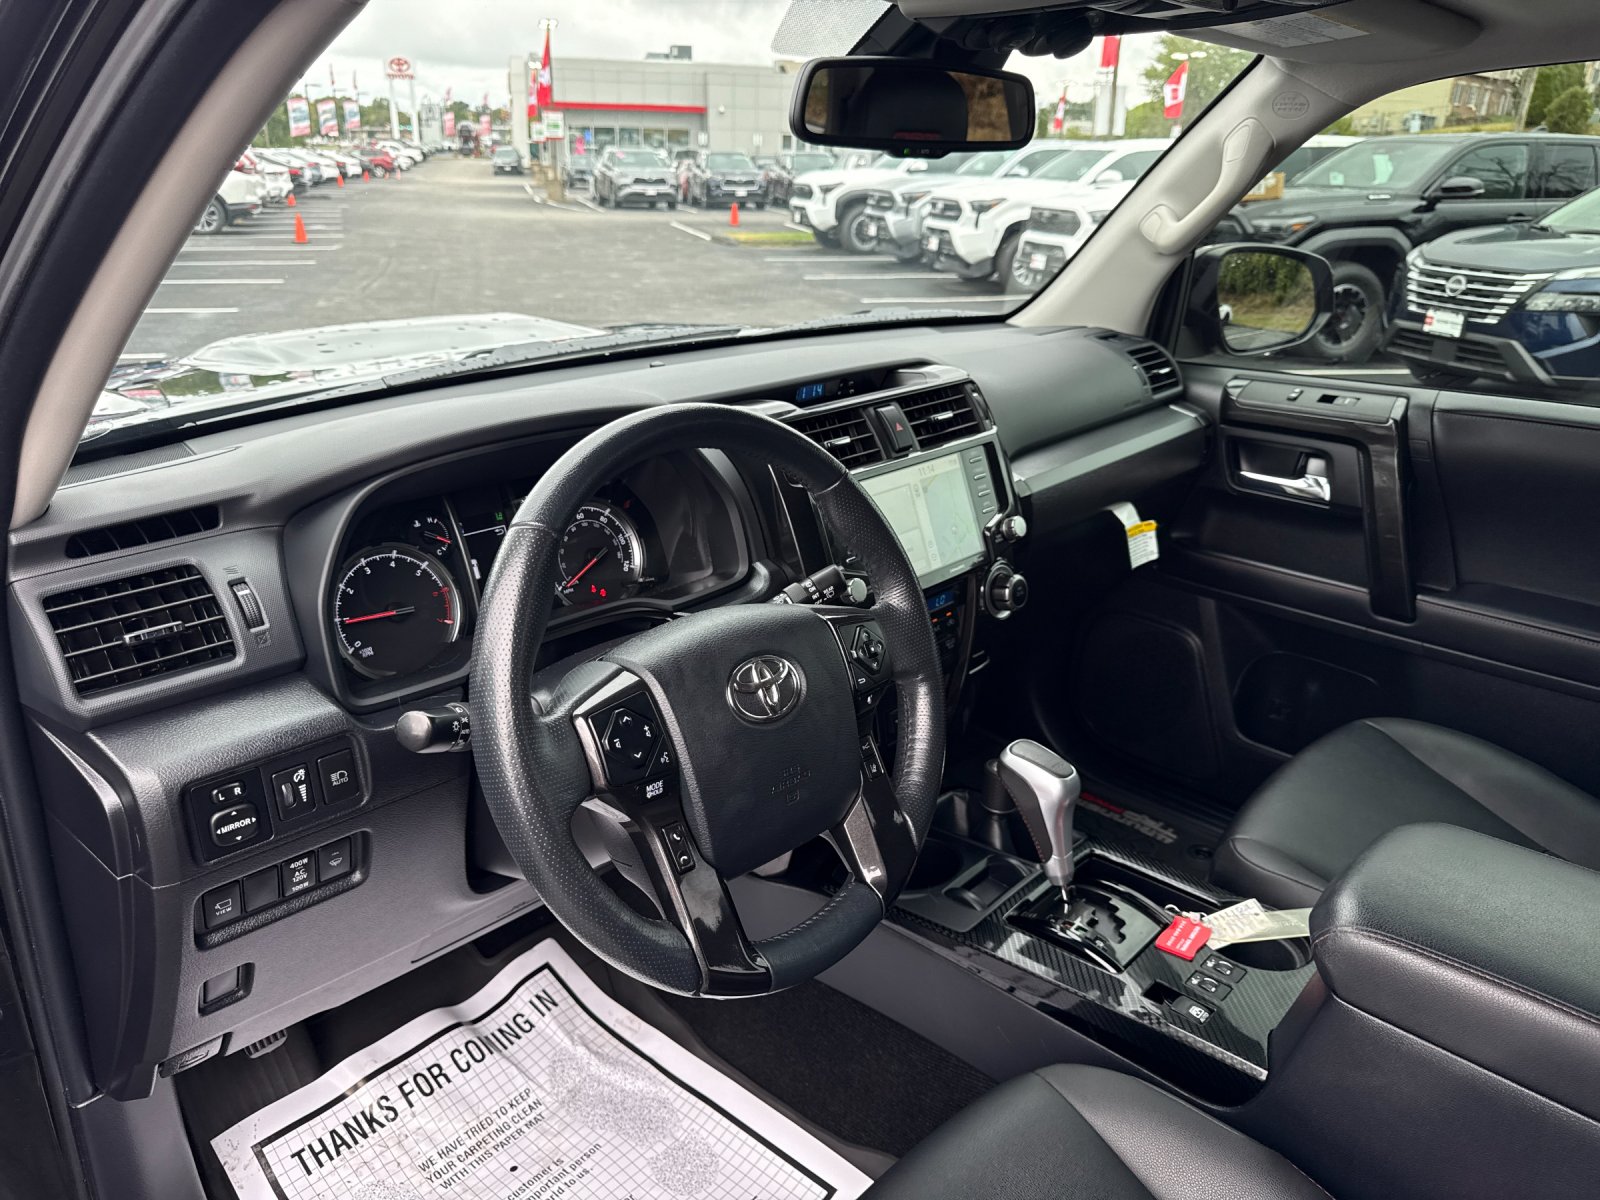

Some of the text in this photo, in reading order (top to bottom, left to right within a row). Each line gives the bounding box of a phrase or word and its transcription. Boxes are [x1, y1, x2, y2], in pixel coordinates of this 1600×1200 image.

[364, 567, 371, 575] 3
[415, 569, 423, 577] 5
[332, 776, 349, 786] AUTO
[646, 780, 663, 792] MODE
[234, 787, 242, 795] R
[221, 818, 251, 834] MIRROR
[290, 857, 308, 868] 400W
[215, 906, 231, 915] VIEW
[290, 1095, 399, 1176] THANKS
[398, 1063, 452, 1108] FOR
[529, 989, 559, 1017] IN
[418, 1087, 532, 1172] WE HAVE TRIED TO KEEP
[426, 1099, 543, 1184] YOUR CARPETING CLEAN
[440, 1112, 546, 1190] WITH THIS PAPER MAT
[569, 1142, 602, 1171] person
[508, 1157, 565, 1200] customer is
[564, 1179, 576, 1188] to
[577, 1167, 594, 1179] us.
